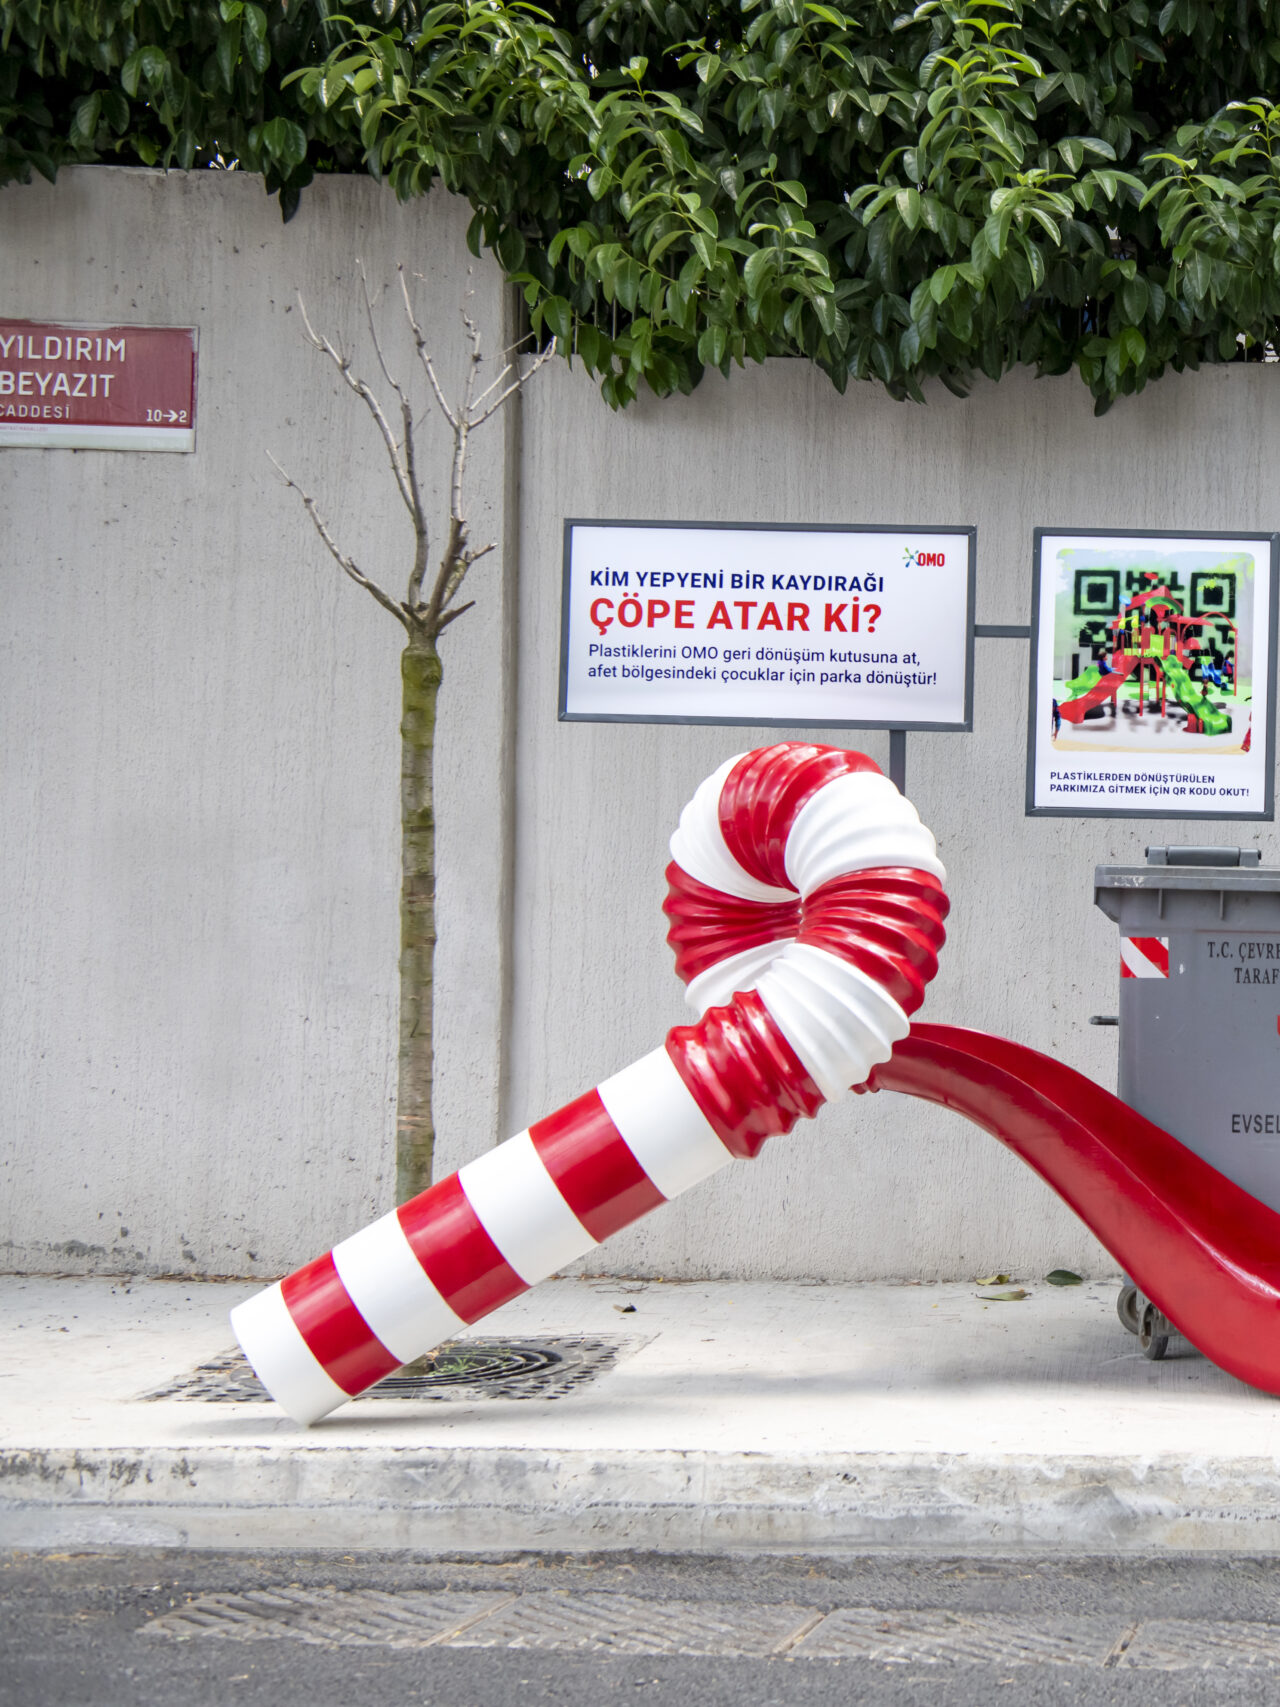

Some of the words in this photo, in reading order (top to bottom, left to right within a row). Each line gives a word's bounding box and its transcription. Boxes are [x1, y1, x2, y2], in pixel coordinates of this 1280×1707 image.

[0, 335, 126, 362] YILDIRIM
[0, 371, 115, 398] BEYAZIT
[146, 409, 162, 422] 10
[178, 410, 187, 423] 2
[917, 552, 946, 567] OMO
[590, 567, 629, 587] KİM
[636, 569, 724, 588] YEPYENİ
[731, 570, 765, 589] BİR
[772, 573, 884, 592] KAYDIRAĞI
[589, 592, 695, 636] ÇÖPE
[706, 601, 810, 631] ATAR
[824, 596, 882, 633] Kİ?
[589, 644, 676, 659] Plastiklerini
[681, 646, 718, 659] OMO
[723, 648, 751, 663] geri
[755, 647, 825, 665] dönüşüm
[829, 649, 898, 664] kutusuna
[902, 652, 920, 666] at,
[588, 664, 617, 677] afet
[622, 665, 716, 681] bölgesindeki
[721, 667, 785, 683] çocuklar
[789, 669, 815, 684] için
[820, 670, 861, 685] parka
[866, 671, 937, 687] dönüştür!
[1050, 771, 1131, 782] PLASTİKLERDEN
[1134, 772, 1215, 784] DÖNÜŞTÜRÜLEN
[1050, 784, 1105, 793] PARKIMIZA
[1108, 784, 1147, 794] GİTMEK
[1149, 785, 1170, 796] İÇİN
[1172, 787, 1187, 796] QR
[1189, 787, 1217, 796] KODU
[1219, 788, 1250, 797] OKUT!
[1208, 941, 1233, 958] T.C.
